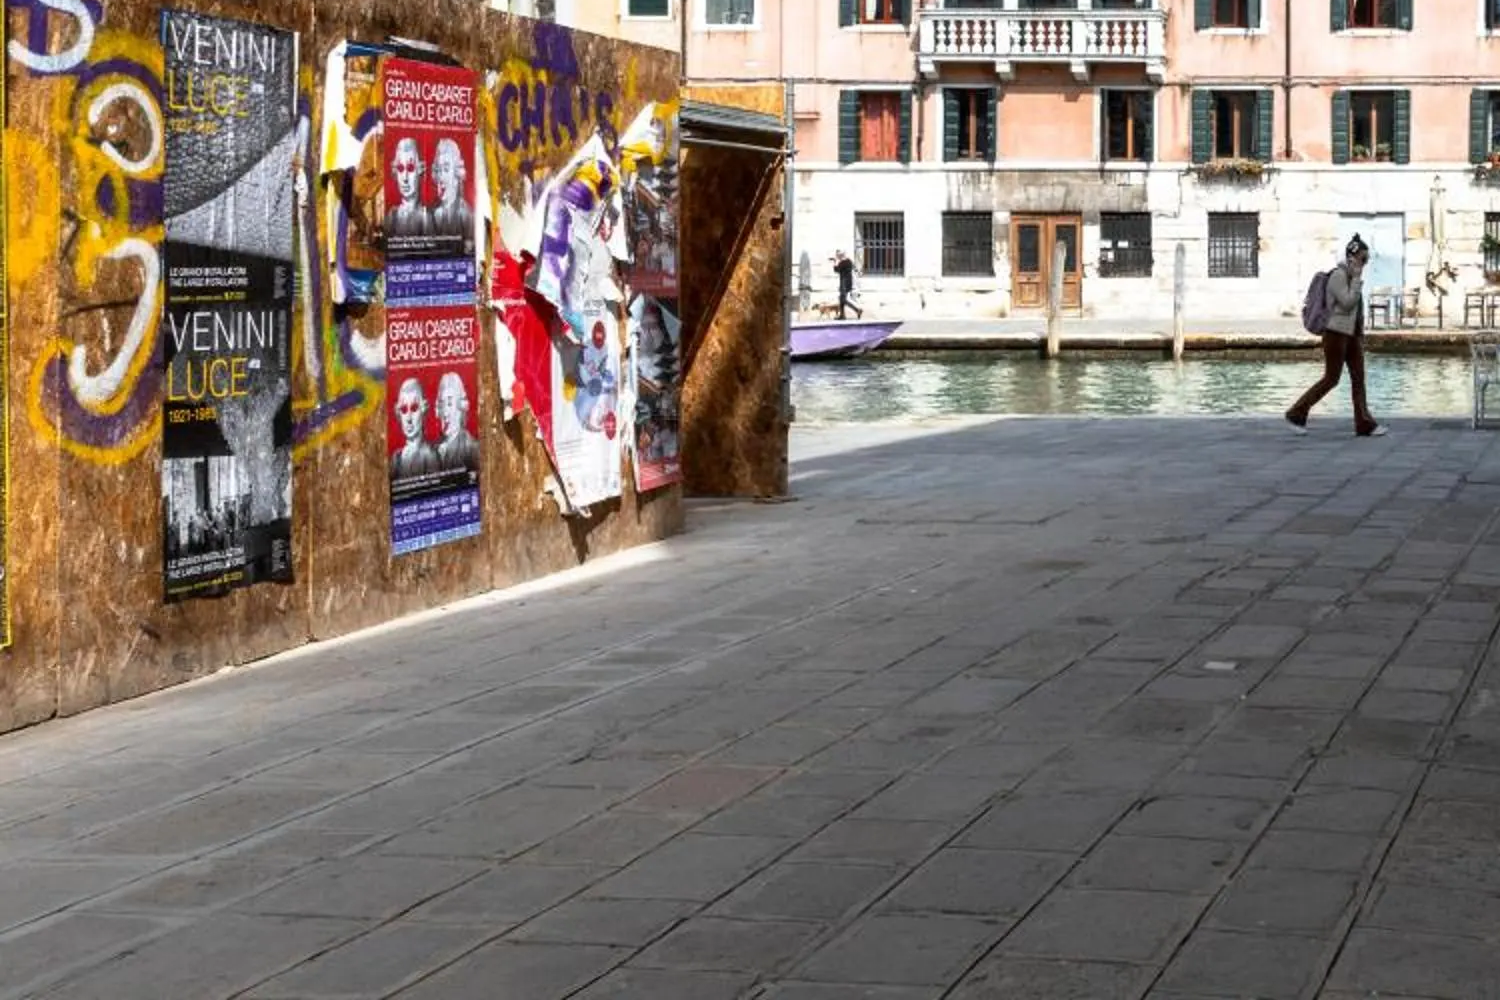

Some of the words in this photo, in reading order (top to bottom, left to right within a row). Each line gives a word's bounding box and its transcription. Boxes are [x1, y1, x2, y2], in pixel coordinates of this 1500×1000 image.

[170, 20, 275, 73] VENINI
[168, 69, 250, 117] LUCE
[385, 78, 421, 99] GRAN
[422, 82, 473, 105] CABARET
[385, 99, 425, 121] CARLO
[427, 103, 435, 121] E
[436, 104, 473, 125] CARLO
[168, 311, 273, 353] VENINI
[389, 320, 423, 342] GRAN
[425, 317, 474, 339] CABARET
[389, 341, 428, 361] CARLO
[430, 340, 437, 359] E
[439, 337, 475, 358] CARLO
[167, 357, 249, 401] LUCE
